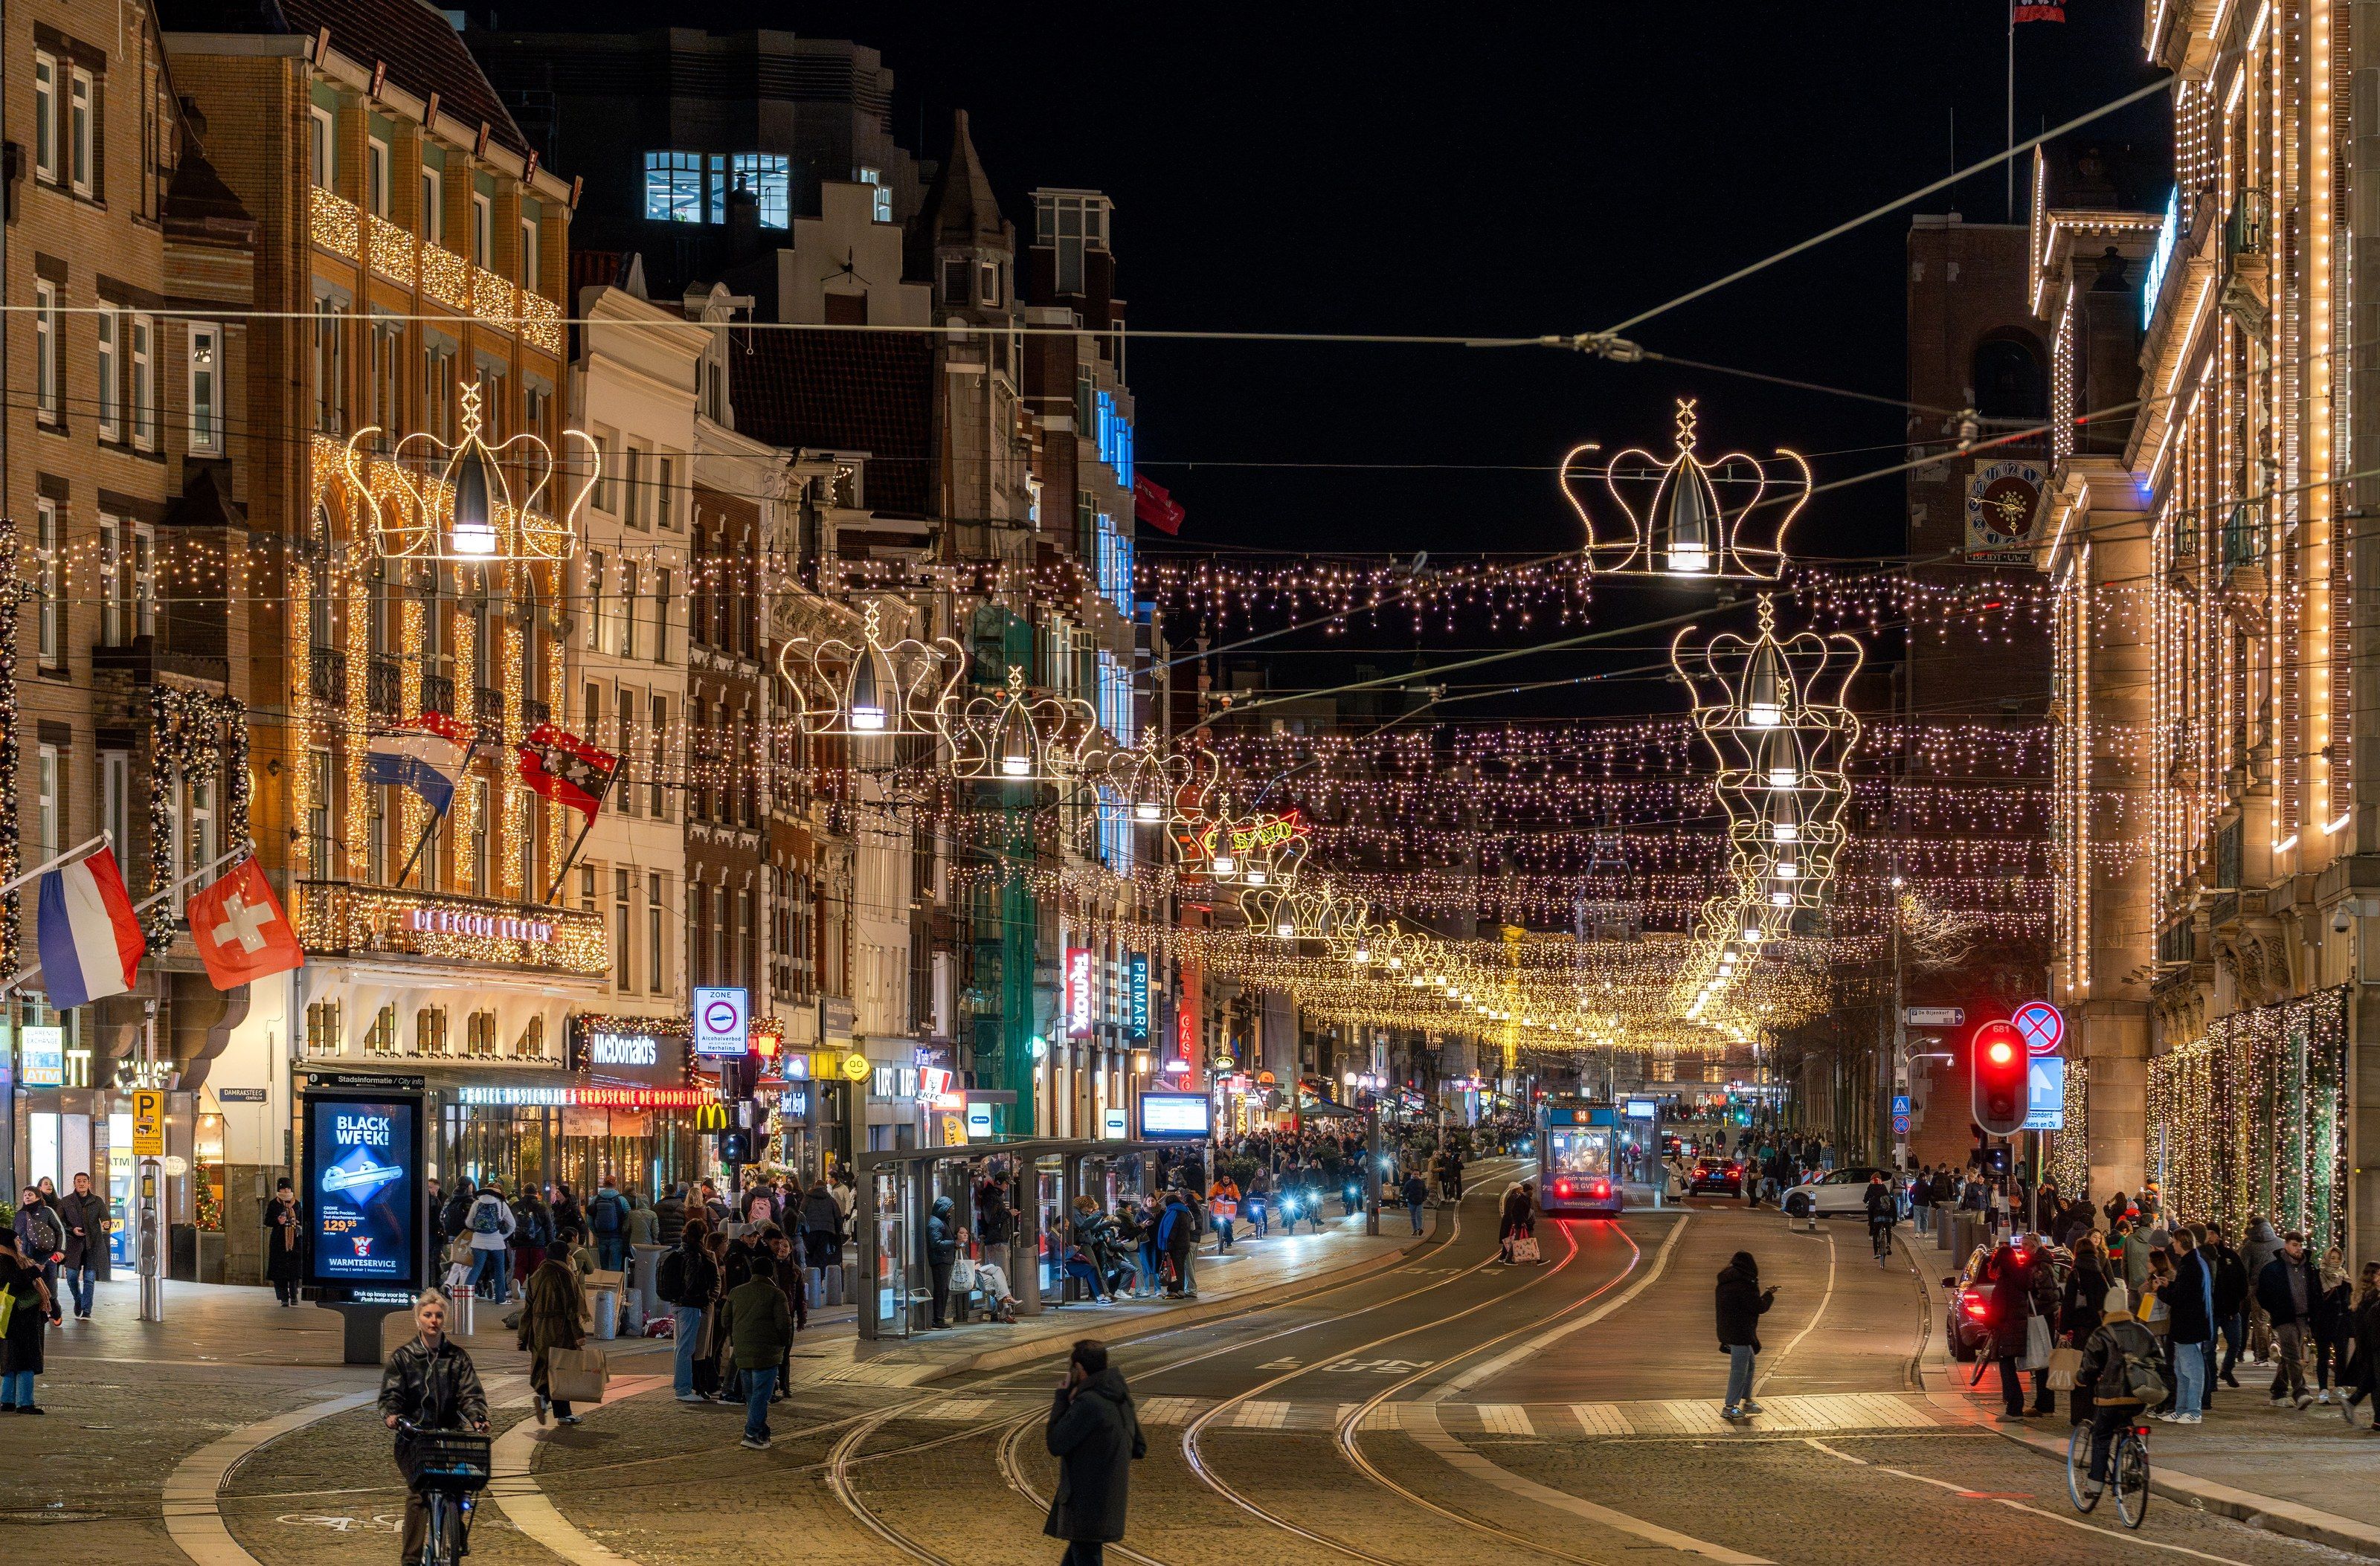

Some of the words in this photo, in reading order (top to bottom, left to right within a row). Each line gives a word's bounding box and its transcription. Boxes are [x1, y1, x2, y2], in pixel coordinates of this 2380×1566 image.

[1204, 822, 1291, 849] CSINO
[1133, 962, 1146, 1037] PRIMARK
[594, 1034, 656, 1065] McDonald's
[26, 1069, 60, 1081] ATM
[338, 1075, 393, 1084] Stadsinformatie
[224, 1089, 263, 1097] DAMRAKSTEEG
[580, 1089, 636, 1104] BRASSERIE
[639, 1090, 652, 1105] DE
[922, 1092, 942, 1102] KFC
[139, 1095, 155, 1118] P
[337, 1115, 390, 1131] BLACK
[1577, 1110, 1586, 1121] 14
[335, 1130, 389, 1146] WEEK!
[329, 1258, 396, 1268] WARMTESERVICE
